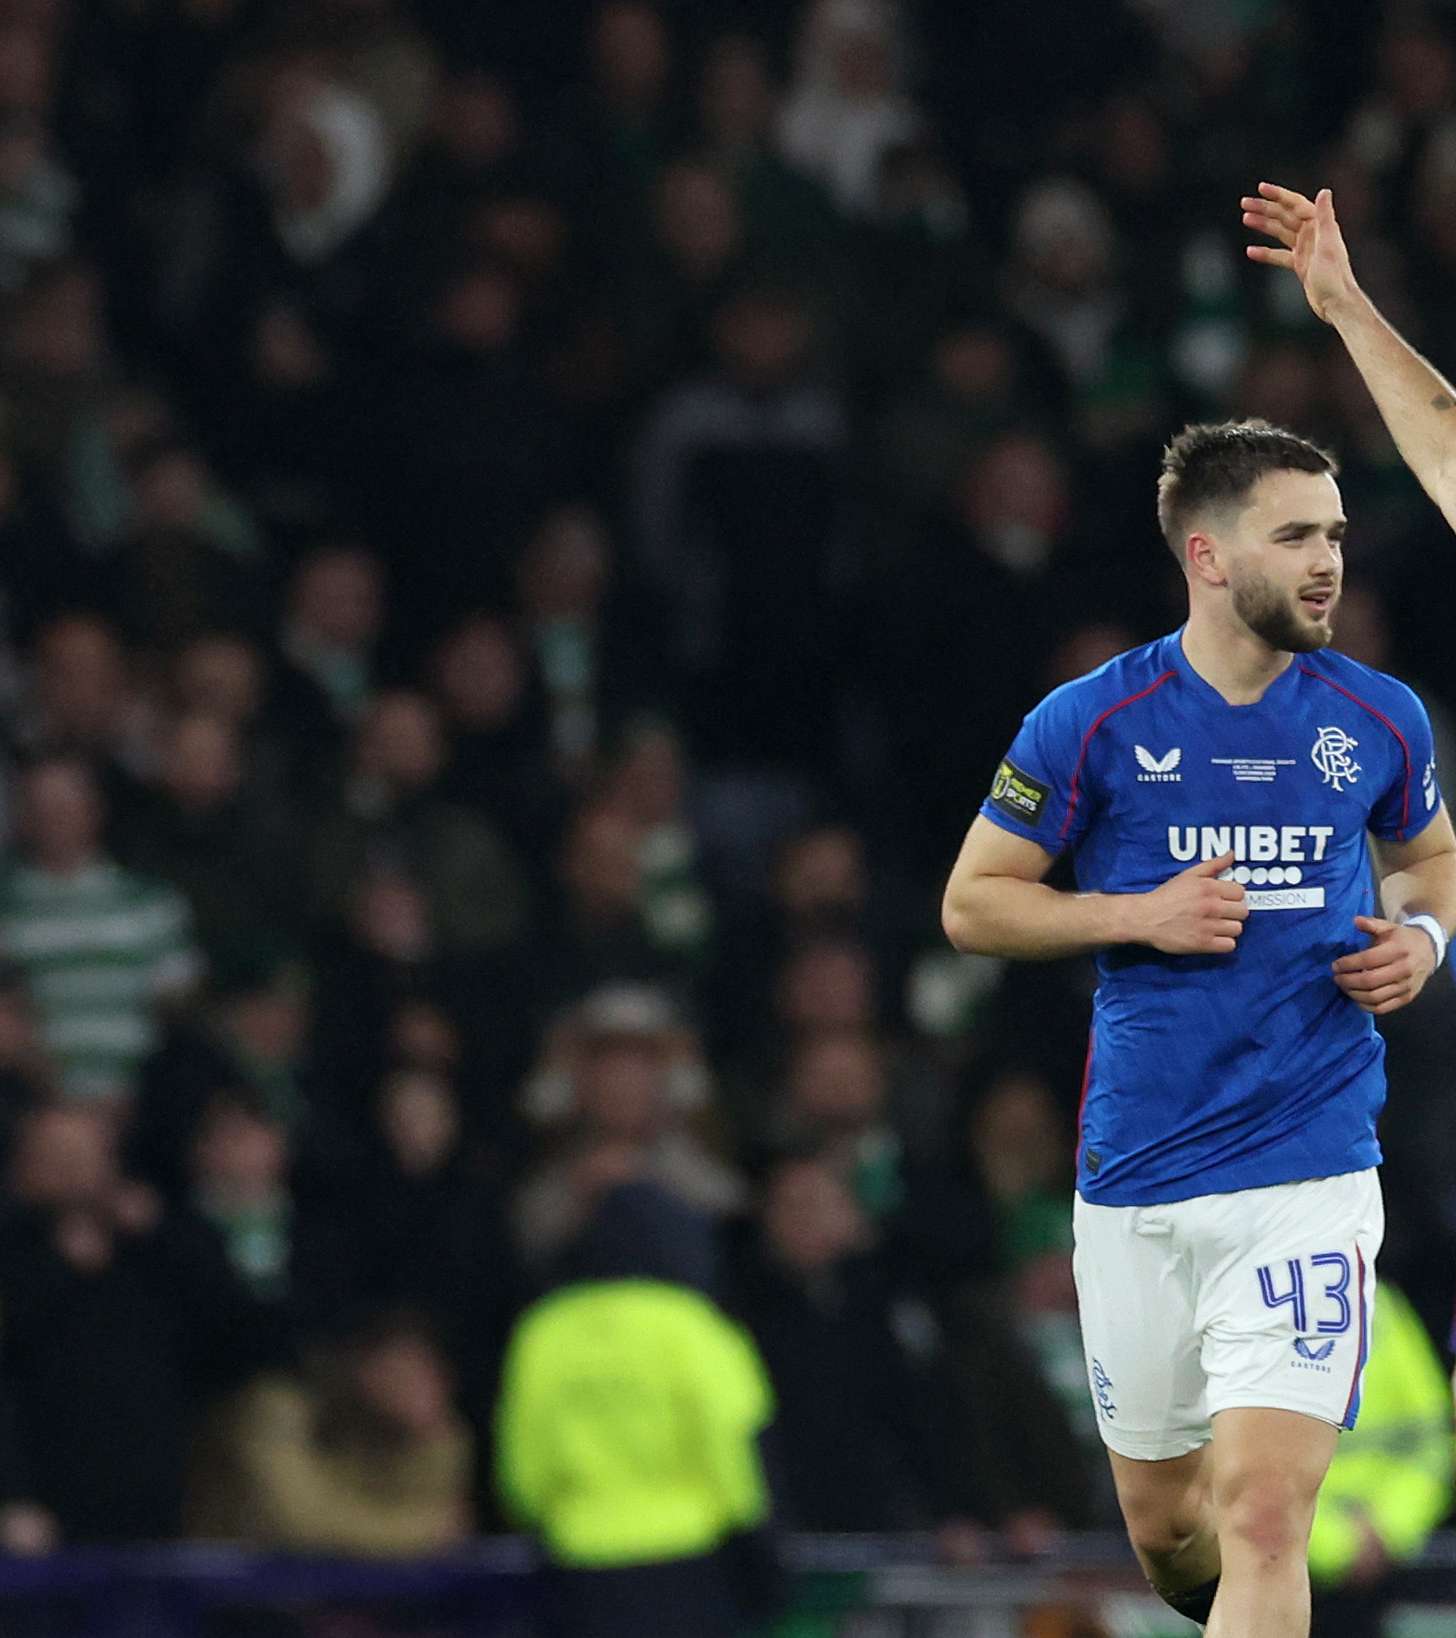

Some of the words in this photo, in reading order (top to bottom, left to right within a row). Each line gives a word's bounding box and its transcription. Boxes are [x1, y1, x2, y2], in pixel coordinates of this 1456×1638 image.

[1168, 825, 1334, 862] UNIBET
[1249, 893, 1308, 907] MISSION
[1256, 1252, 1351, 1333] 43
